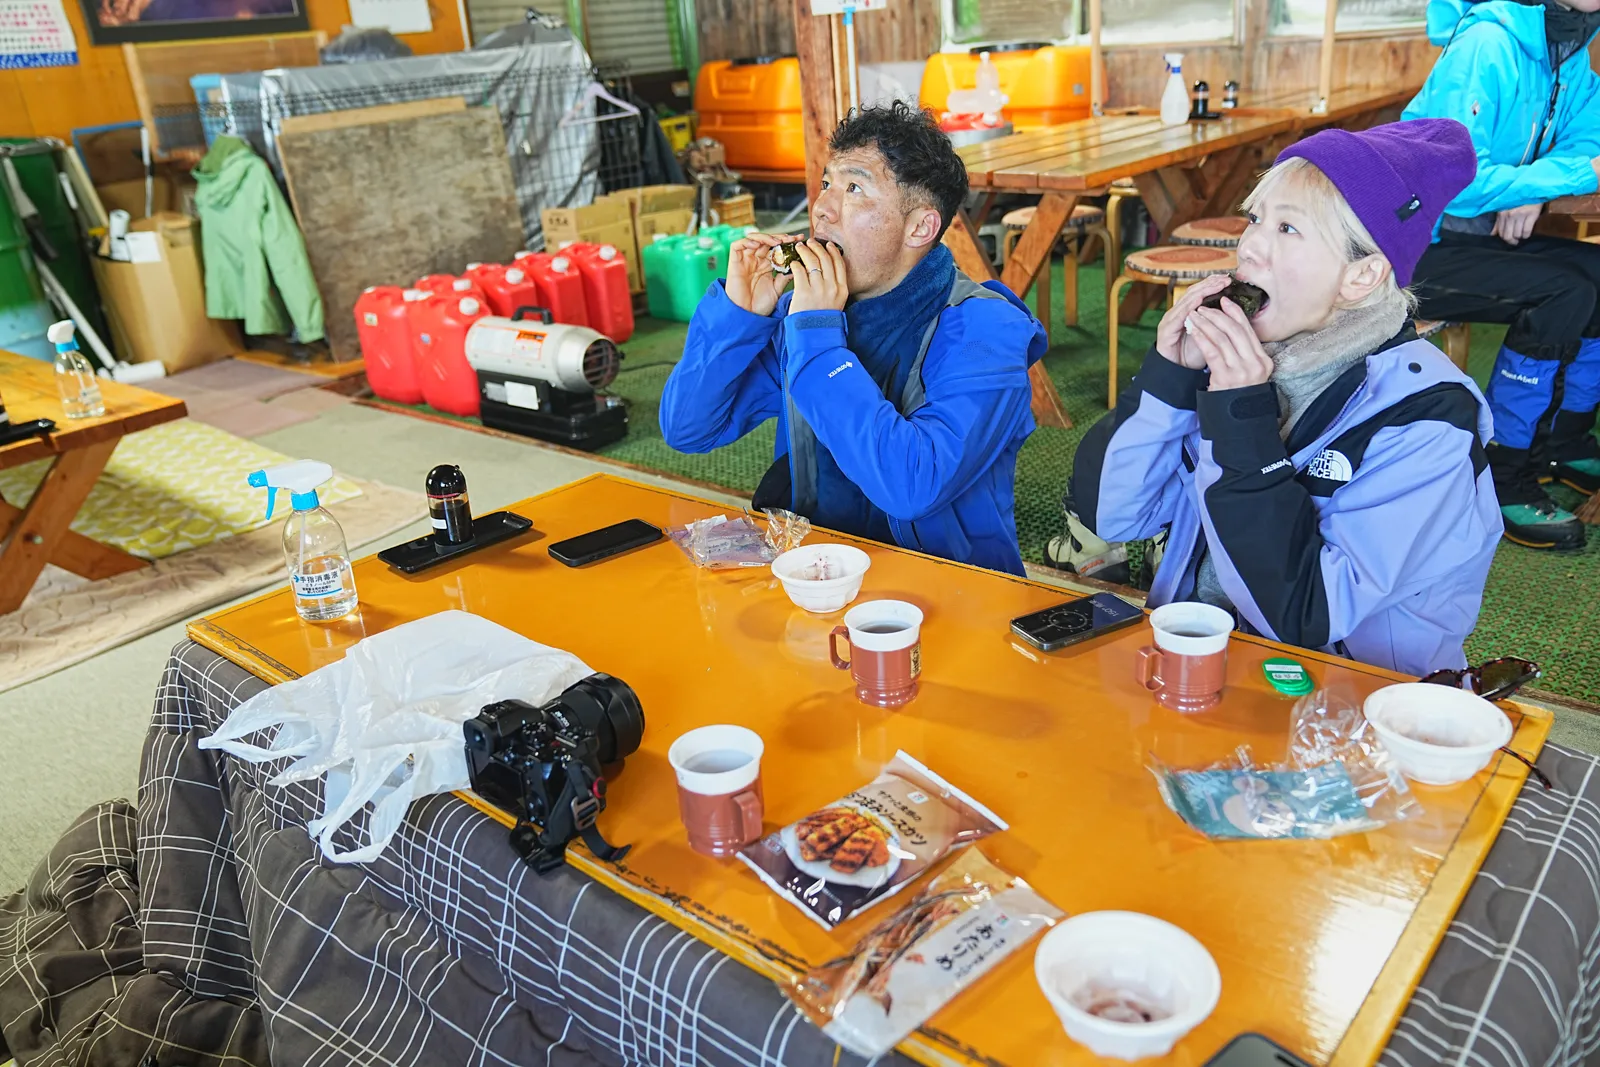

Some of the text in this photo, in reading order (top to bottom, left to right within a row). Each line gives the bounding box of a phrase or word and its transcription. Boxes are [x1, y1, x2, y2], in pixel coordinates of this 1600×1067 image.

[1307, 466, 1331, 479] FACE
[300, 571, 338, 583] 手指消毒液
